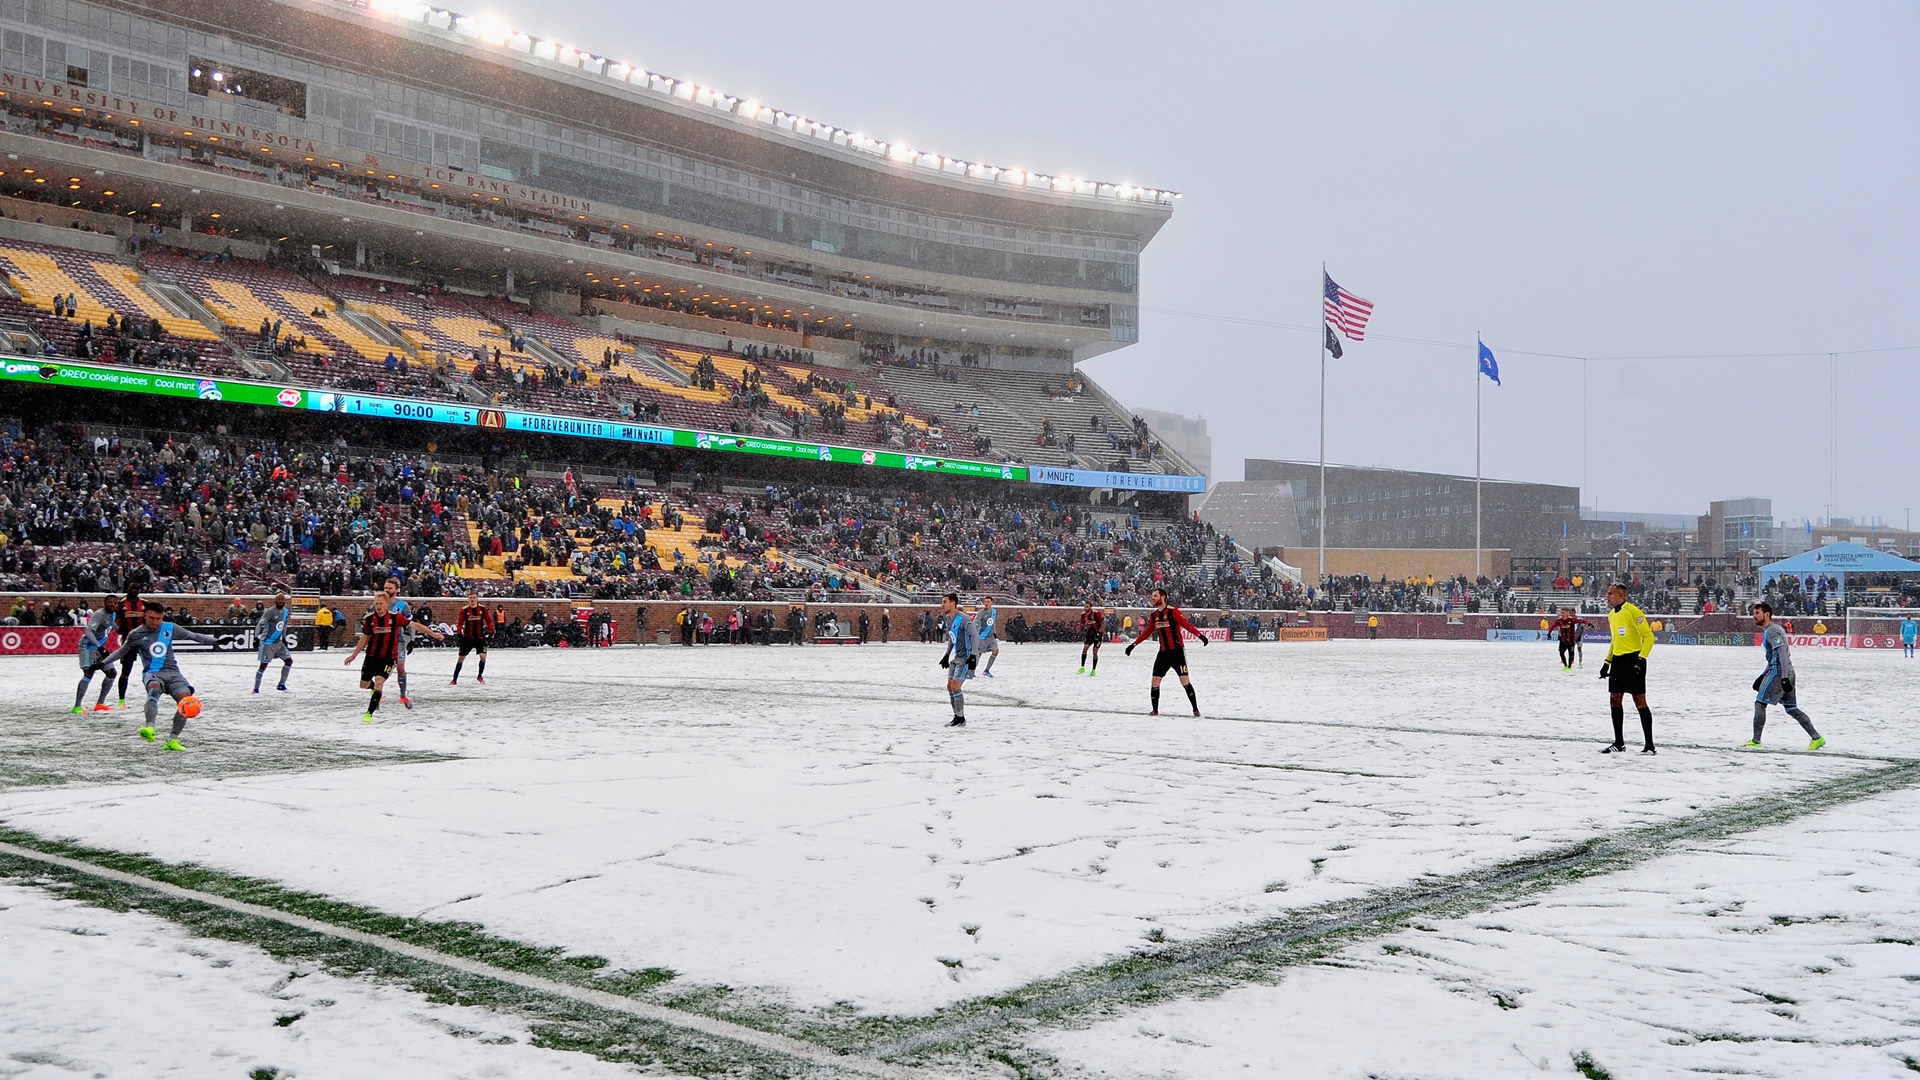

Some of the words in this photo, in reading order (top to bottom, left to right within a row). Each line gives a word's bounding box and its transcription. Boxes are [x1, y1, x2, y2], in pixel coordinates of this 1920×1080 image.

[2, 73, 139, 113] NIVERSITY
[153, 107, 179, 121] OF
[191, 115, 315, 152] MINNESOTA
[424, 167, 455, 182] TCF
[467, 176, 511, 194] BANK
[520, 189, 592, 211] STADIUM
[89, 372, 119, 383] cookie
[120, 376, 148, 386] pieces
[154, 378, 175, 389] Cool
[176, 381, 195, 391] mint
[282, 394, 298, 403] DQ
[355, 400, 361, 411] 1
[394, 404, 433, 418] 90:00
[463, 411, 471, 422] 5
[522, 417, 603, 436] #FOREVERUNITED
[622, 427, 663, 442] #MINvATL
[1047, 471, 1075, 482] MNUFC
[219, 630, 298, 650] adis
[1281, 629, 1310, 640] Continental
[1787, 636, 1847, 646] VOCARE
[1180, 665, 1188, 674] 16
